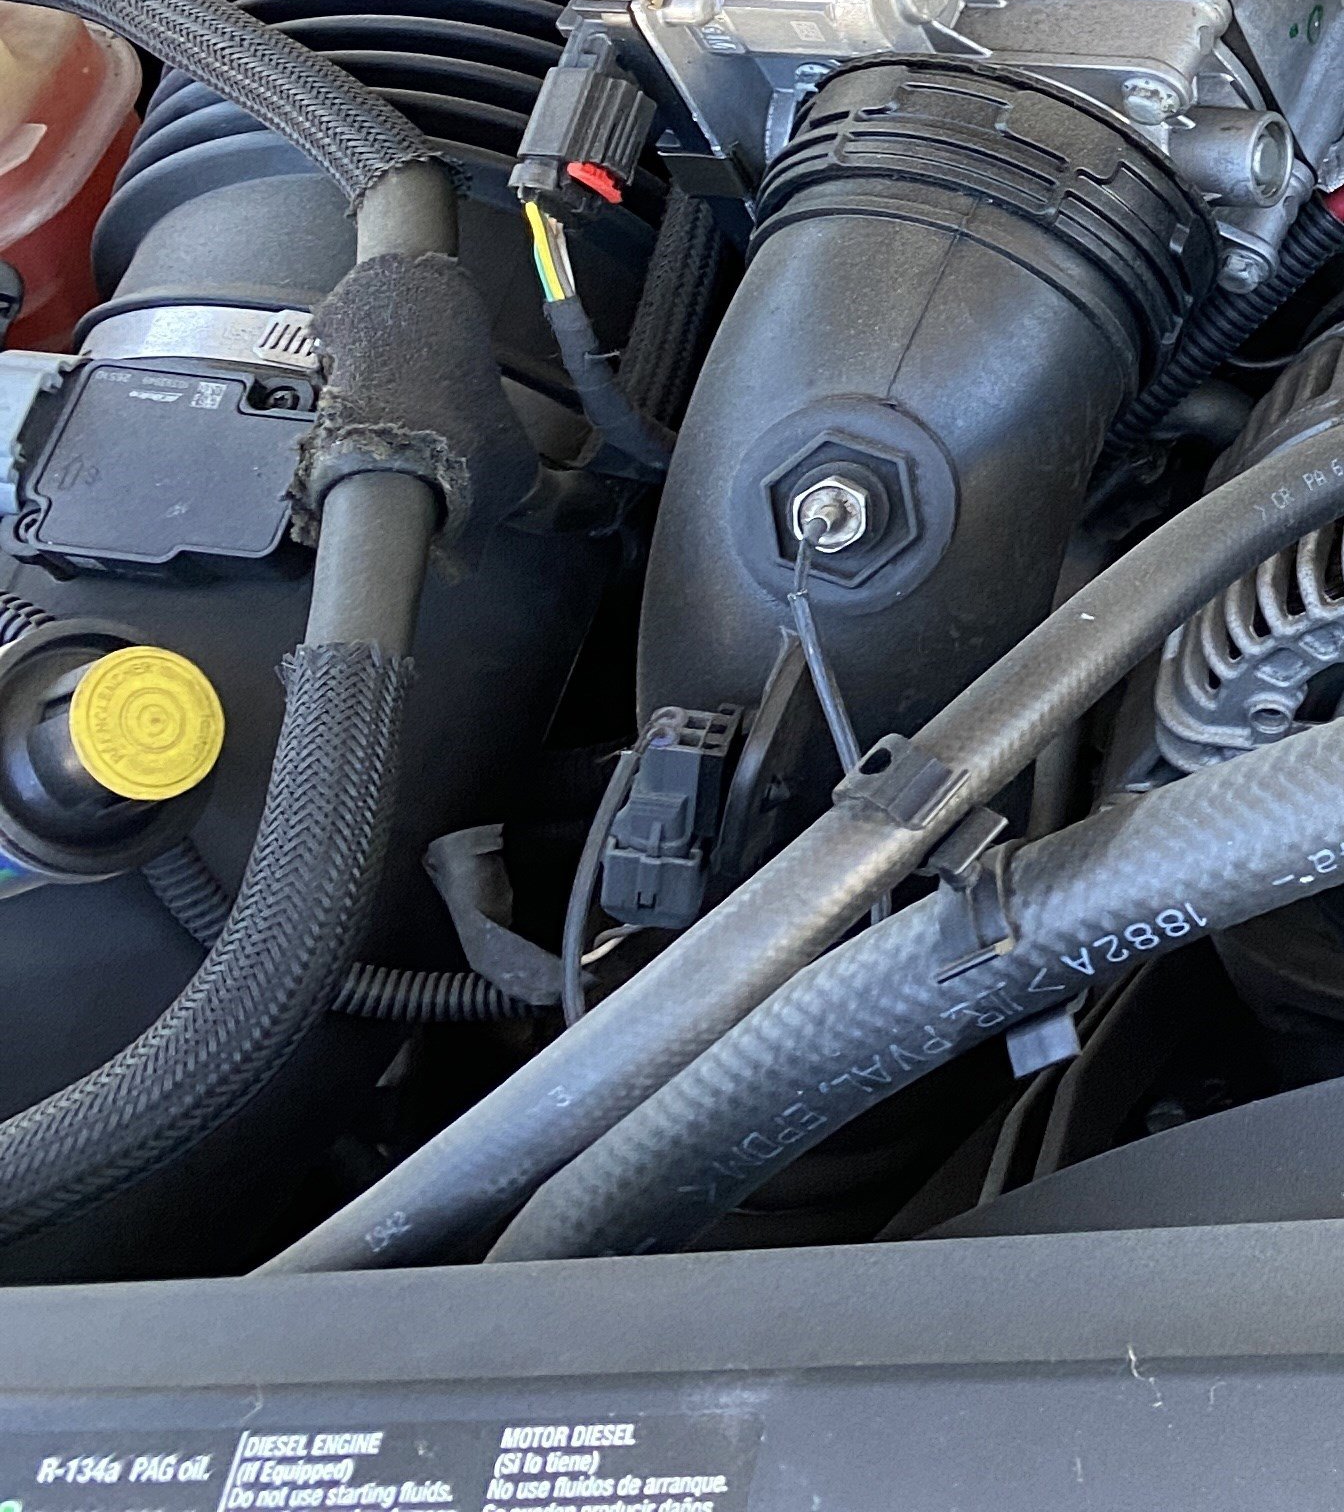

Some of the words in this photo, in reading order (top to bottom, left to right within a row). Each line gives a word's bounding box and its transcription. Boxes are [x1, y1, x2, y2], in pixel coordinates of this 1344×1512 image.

[1060, 902, 1209, 977] 1882A
[244, 1434, 309, 1457] DIESEL
[310, 1431, 385, 1456] ENGINE
[500, 1426, 570, 1449] MOTOR
[570, 1423, 637, 1447] DIESEL
[36, 1454, 123, 1484] R-134a
[128, 1453, 180, 1482] PAG
[177, 1453, 215, 1482] oil.
[236, 1459, 263, 1485] (If
[259, 1457, 355, 1486] Equipped)
[493, 1452, 522, 1478] (Si
[523, 1452, 543, 1474] lo
[545, 1450, 601, 1476] tiene)
[228, 1487, 255, 1509] Do
[255, 1485, 288, 1508] not
[288, 1487, 324, 1508] use
[325, 1482, 397, 1509] starting
[398, 1480, 454, 1504] fluids.
[486, 1477, 513, 1500] No
[516, 1481, 550, 1500] use
[552, 1475, 615, 1498] fluidos
[616, 1474, 642, 1496] de
[643, 1474, 729, 1497] arranque.
